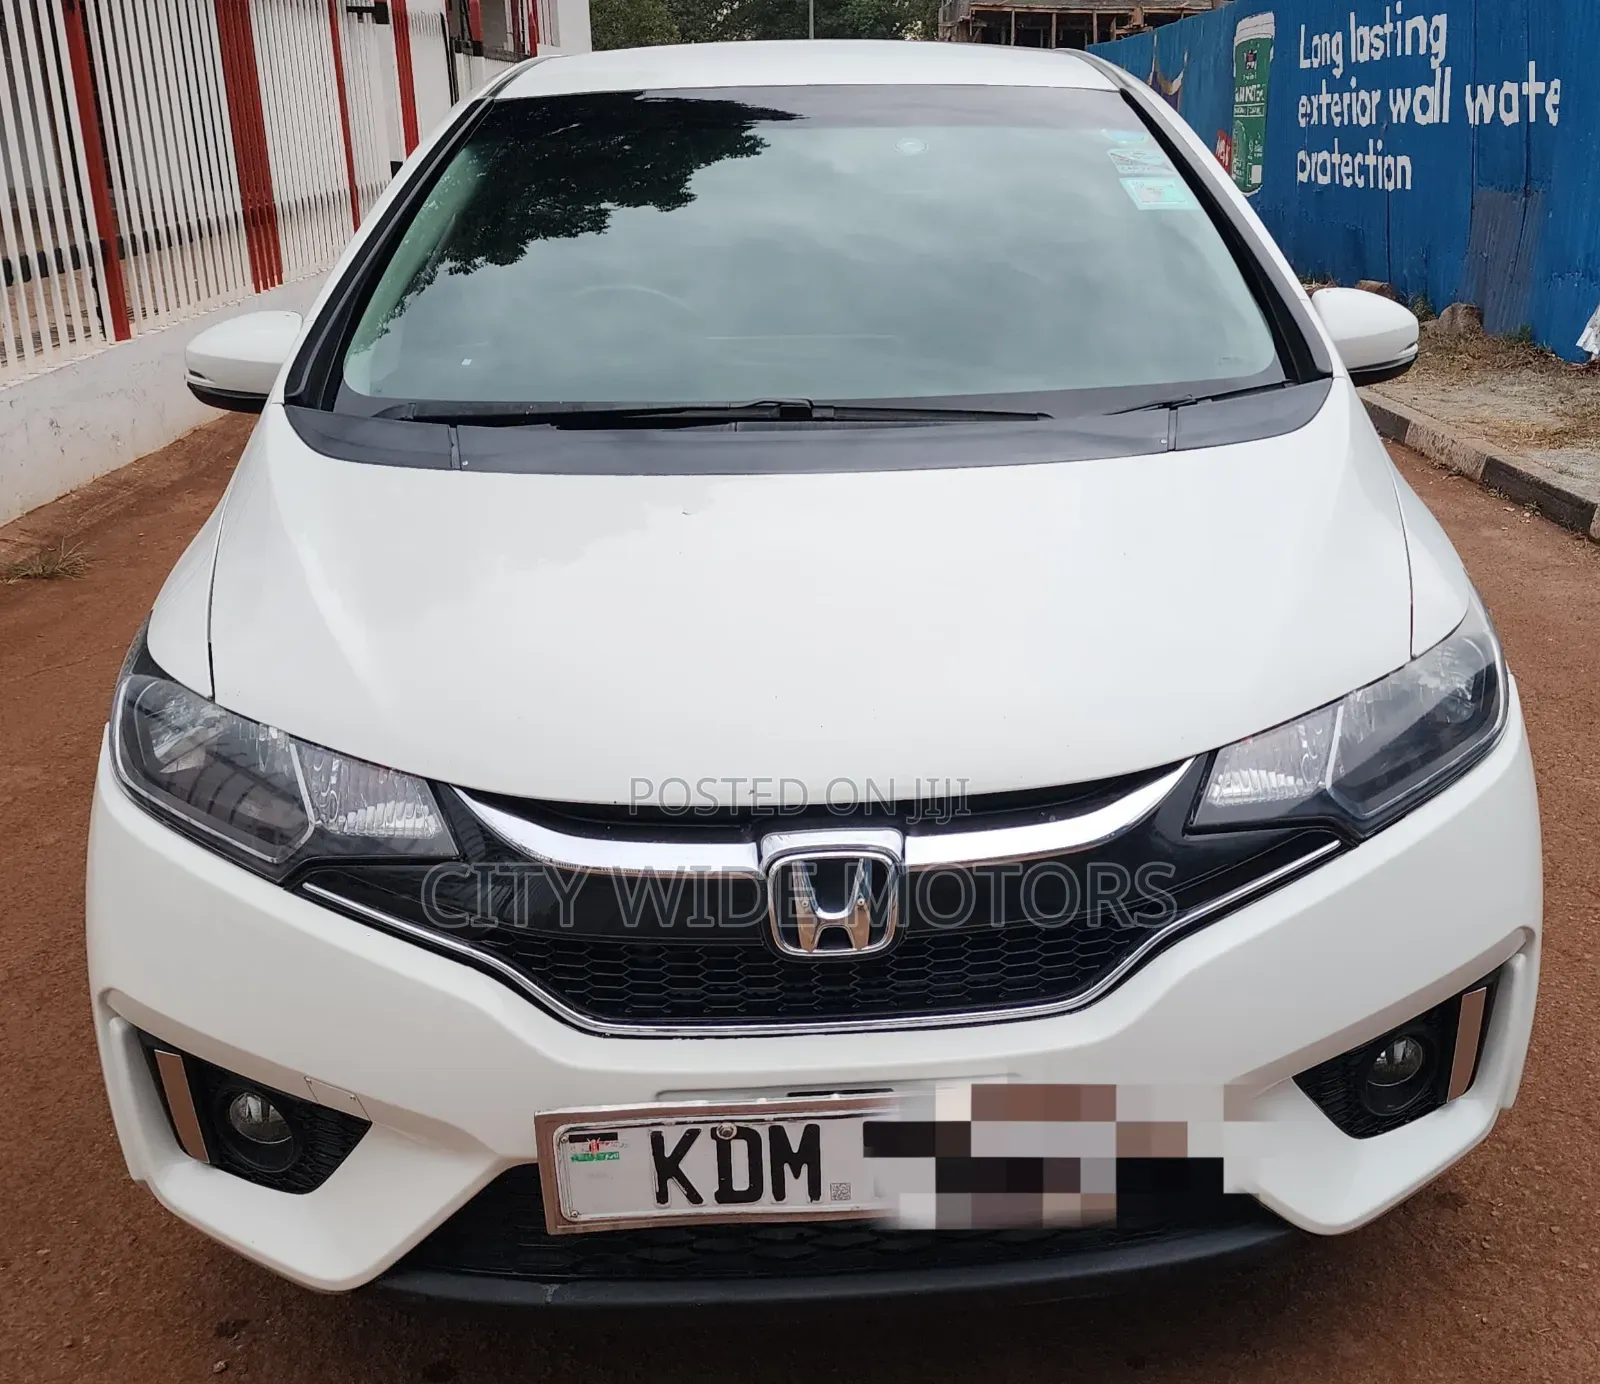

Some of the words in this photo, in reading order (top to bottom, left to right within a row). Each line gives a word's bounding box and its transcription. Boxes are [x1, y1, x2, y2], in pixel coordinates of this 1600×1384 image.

[1300, 24, 1343, 78] Long
[1350, 1, 1448, 69] lasting
[1297, 76, 1381, 128] exterior
[1389, 66, 1452, 126] wall
[1465, 60, 1561, 127] wate
[651, 1123, 822, 1206] KDM
